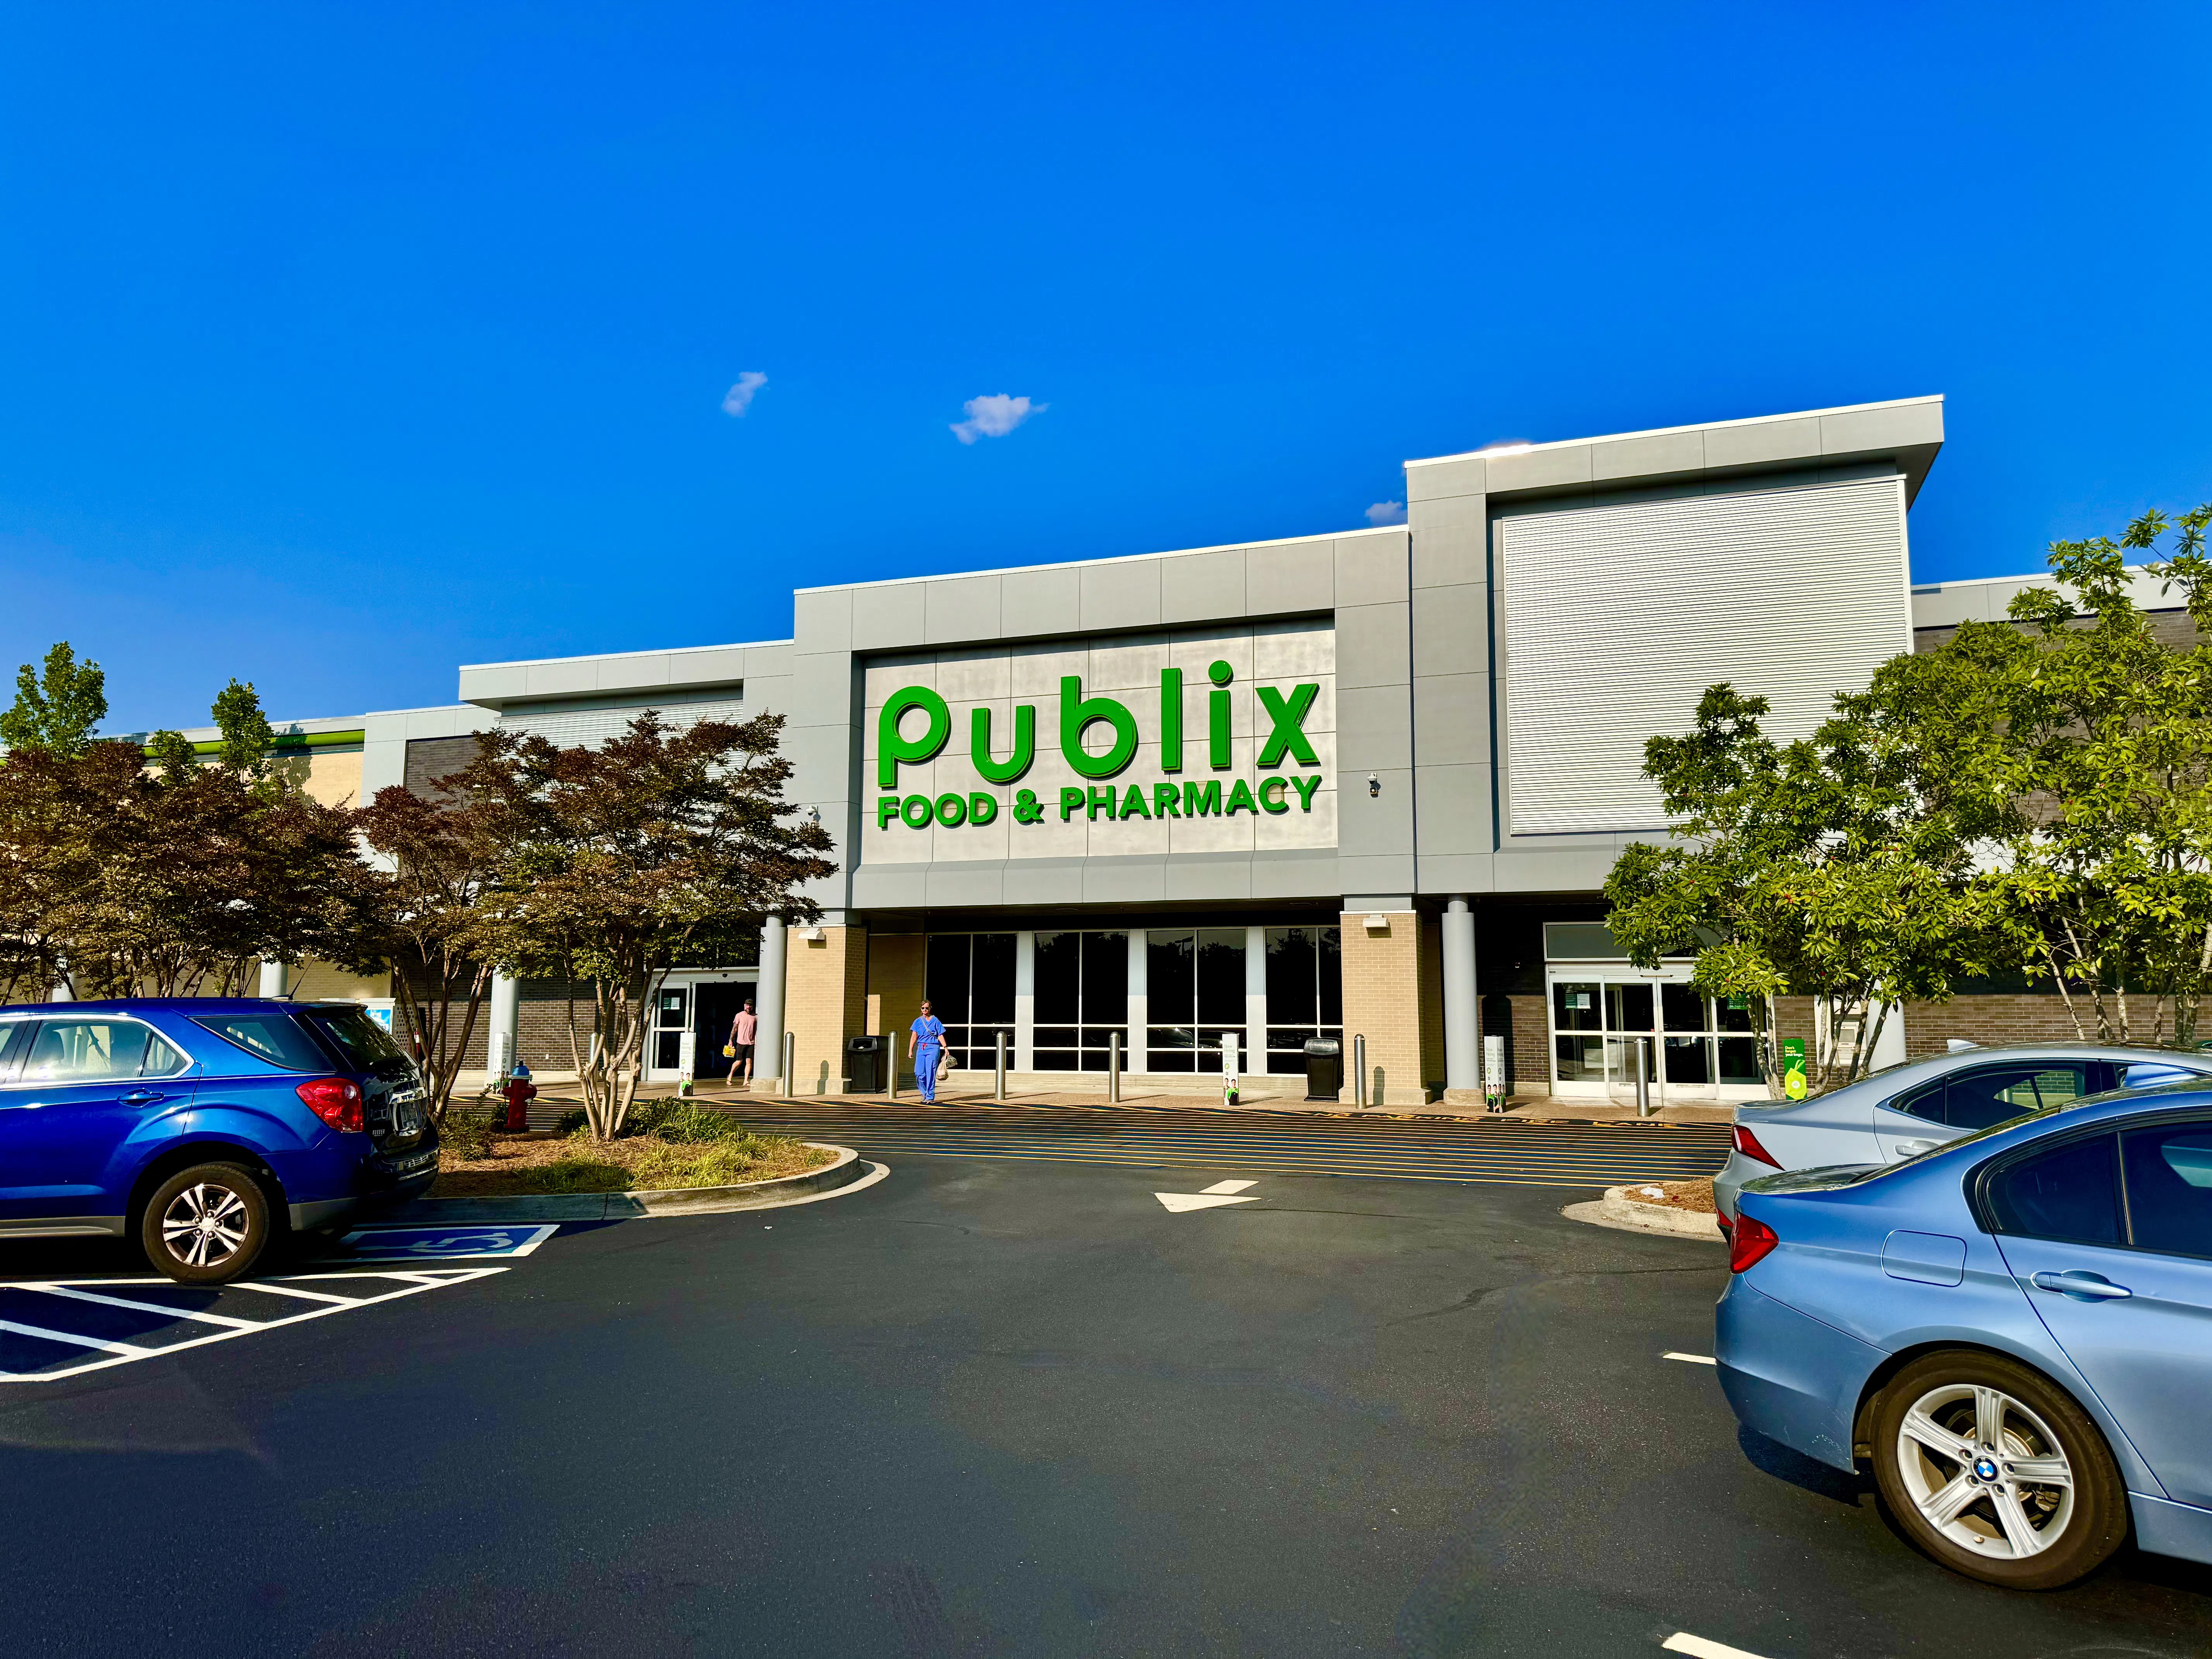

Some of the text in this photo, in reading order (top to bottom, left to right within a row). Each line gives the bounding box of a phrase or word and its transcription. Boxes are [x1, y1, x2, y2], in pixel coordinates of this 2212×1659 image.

[878, 660, 1320, 788] Publix
[878, 775, 1322, 828] FOOD & PHARMACY
